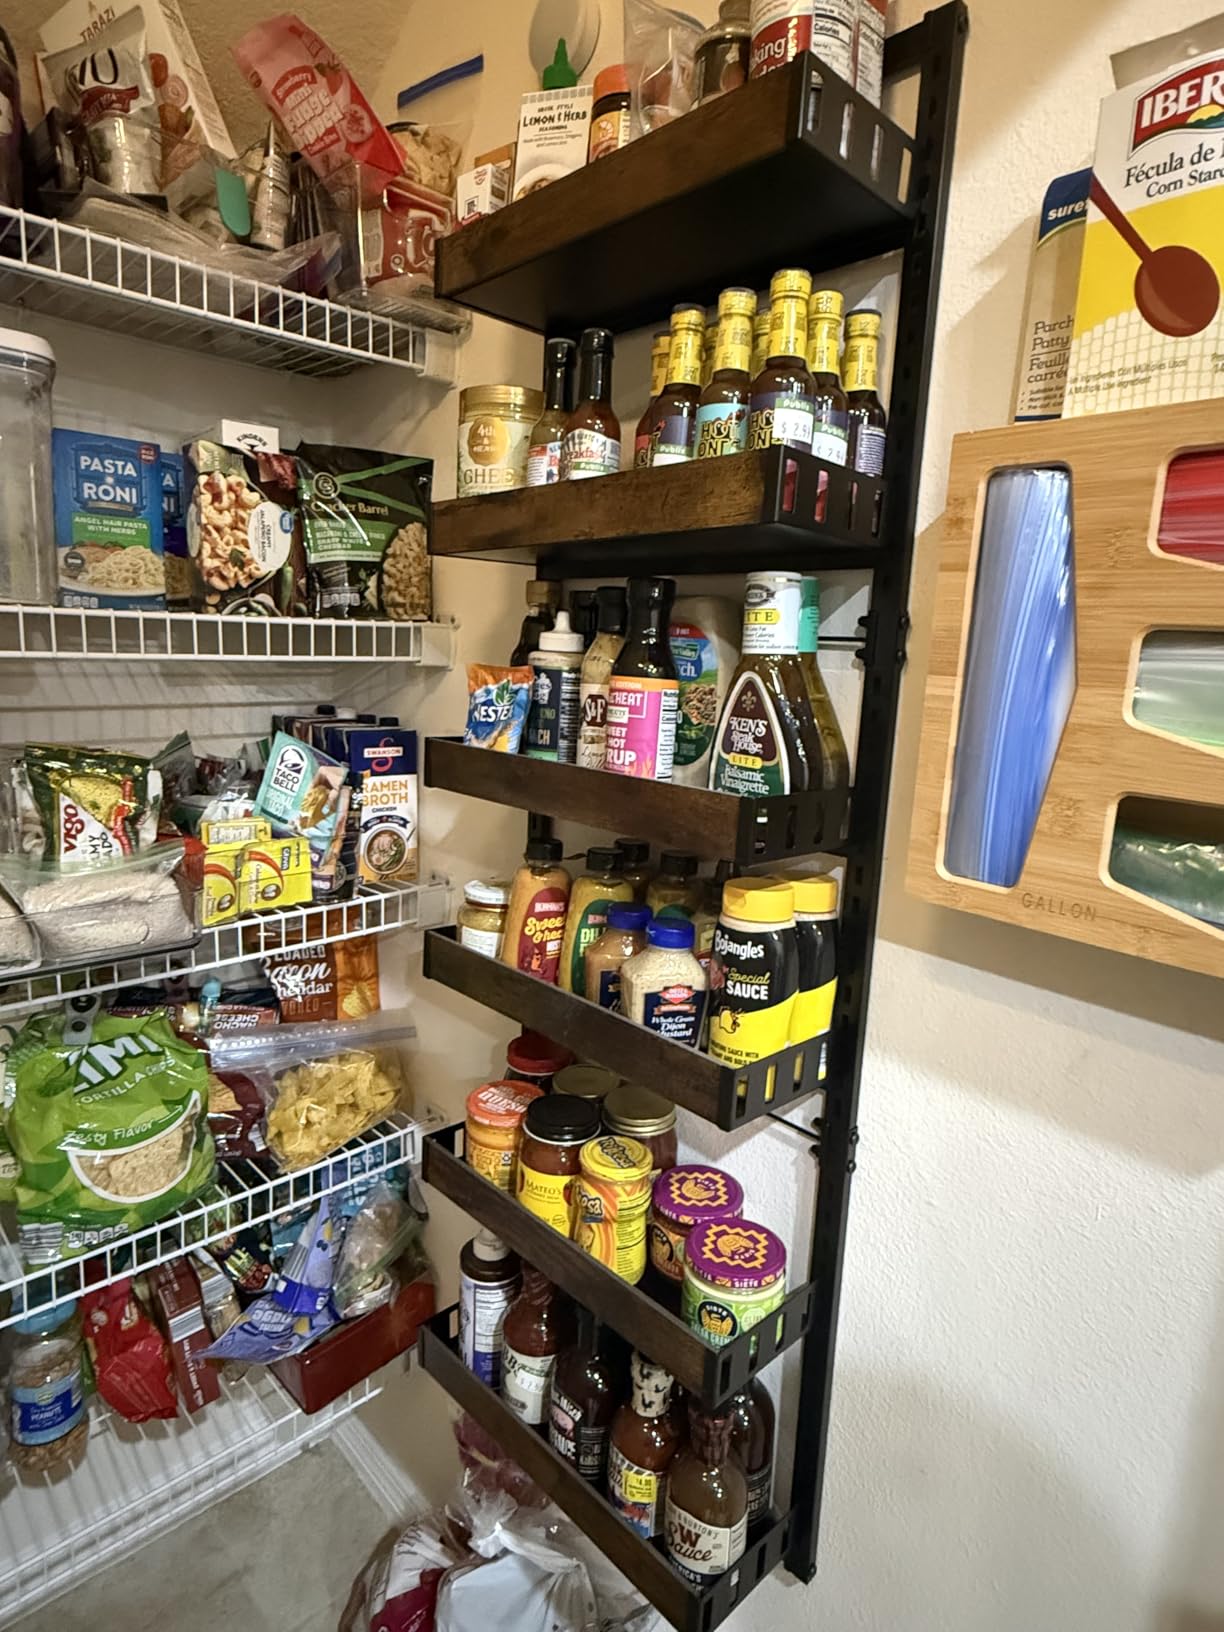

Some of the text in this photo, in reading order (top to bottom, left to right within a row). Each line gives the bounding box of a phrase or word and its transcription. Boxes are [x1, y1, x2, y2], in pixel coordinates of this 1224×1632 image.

[80, 8, 116, 42] TARAZI
[1124, 143, 1215, 188] Fécula de
[1146, 179, 1183, 198] Corn
[1032, 336, 1070, 351] Patty
[80, 456, 138, 478] PASTA
[463, 468, 515, 485] GHEE
[83, 482, 138, 505] RONI
[358, 502, 389, 516] Barrel
[74, 516, 148, 530] ANGEL HAIR PASTA
[87, 524, 137, 536] WITH HERBS
[746, 611, 774, 622] ITE
[729, 716, 768, 737] KEN'S
[732, 755, 758, 766] LITE
[275, 768, 300, 785] TACO
[724, 764, 765, 782] Balsamic
[273, 777, 296, 793] BELL
[361, 780, 408, 794] RAMEN
[720, 773, 770, 794] Vinaigrette
[1021, 892, 1096, 921] GALLON
[715, 929, 764, 960] Bojangles
[728, 967, 770, 985] Special
[726, 980, 768, 1000] SAUCE
[661, 1022, 686, 1031] Dijon
[76, 1072, 146, 1105] ORTILLA
[113, 1120, 154, 1140] Flavor
[705, 1304, 728, 1316] SIETE
[667, 1520, 713, 1562] Sauce
[678, 1523, 701, 1548] W
